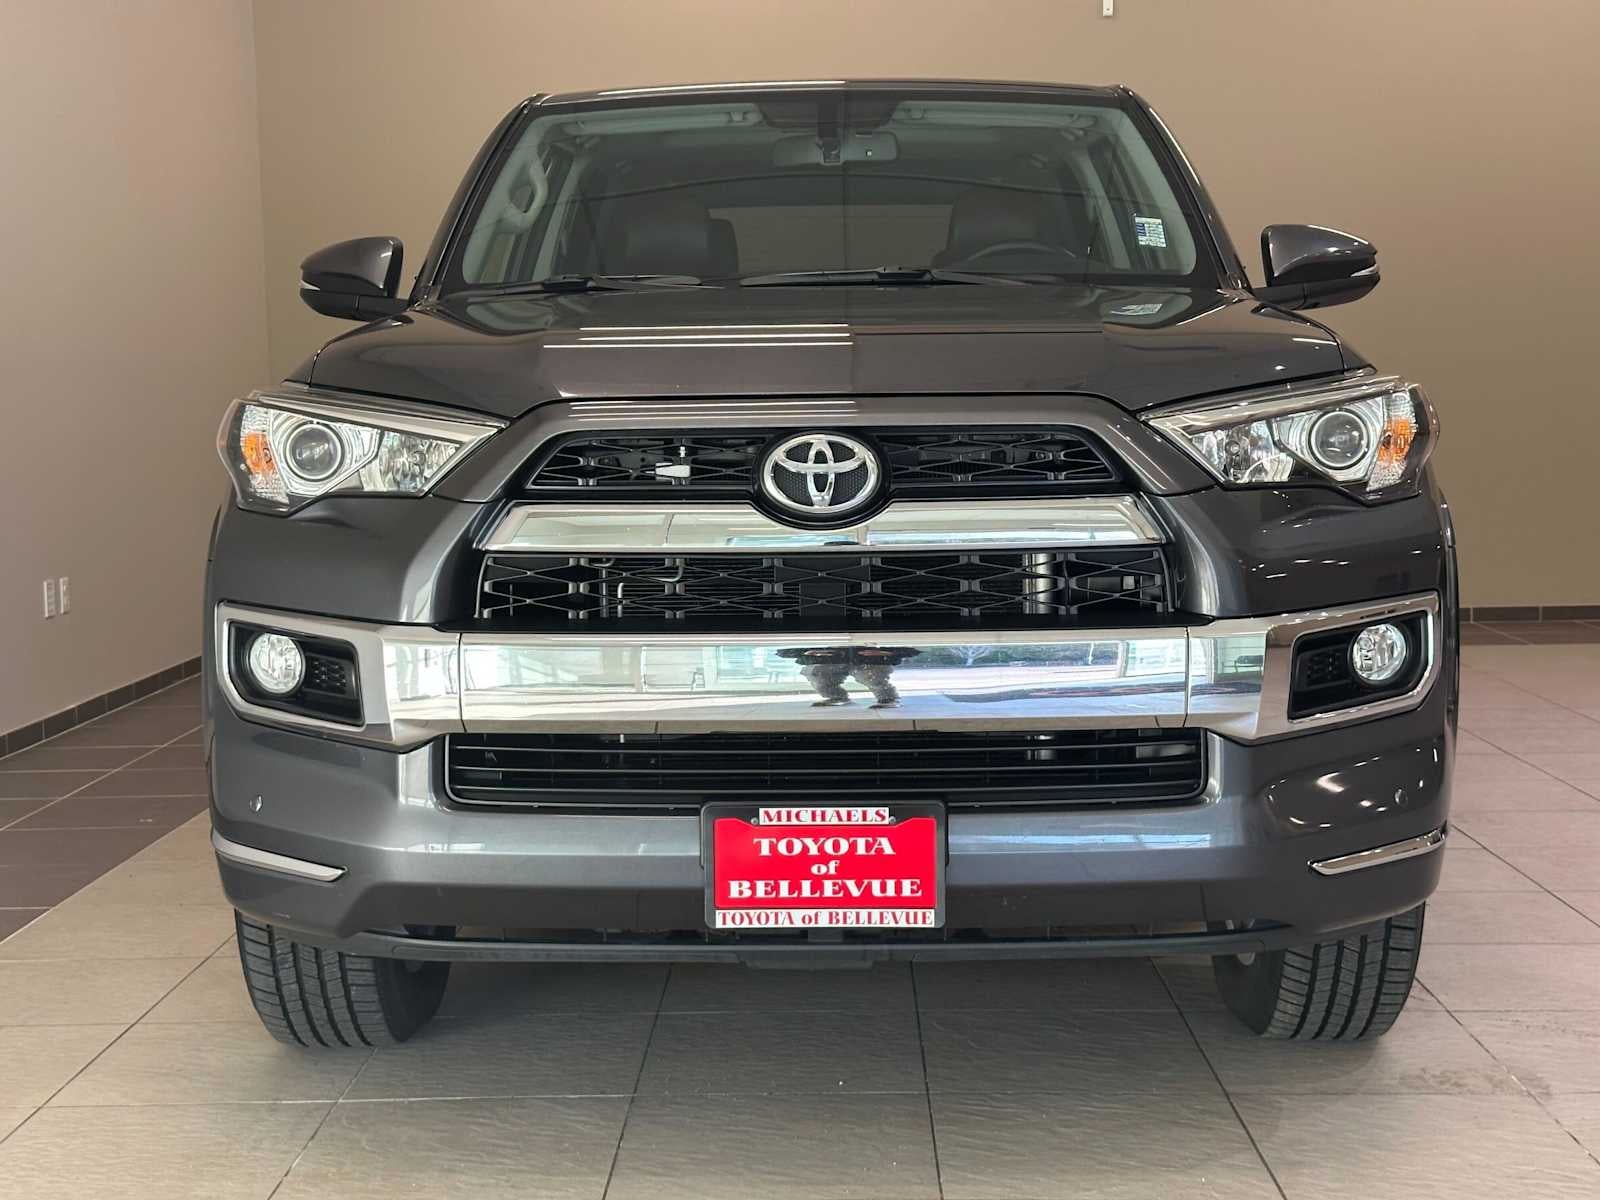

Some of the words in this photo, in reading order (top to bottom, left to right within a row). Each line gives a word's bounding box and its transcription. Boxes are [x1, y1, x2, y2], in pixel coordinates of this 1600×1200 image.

[762, 809, 888, 824] MICHAELS
[753, 837, 896, 856] TOYOTA
[810, 860, 841, 876] of
[728, 879, 923, 899] BELLEVUE
[718, 911, 796, 926] TOYOTA
[802, 911, 822, 925] of
[827, 910, 933, 926] BELLEVUE
